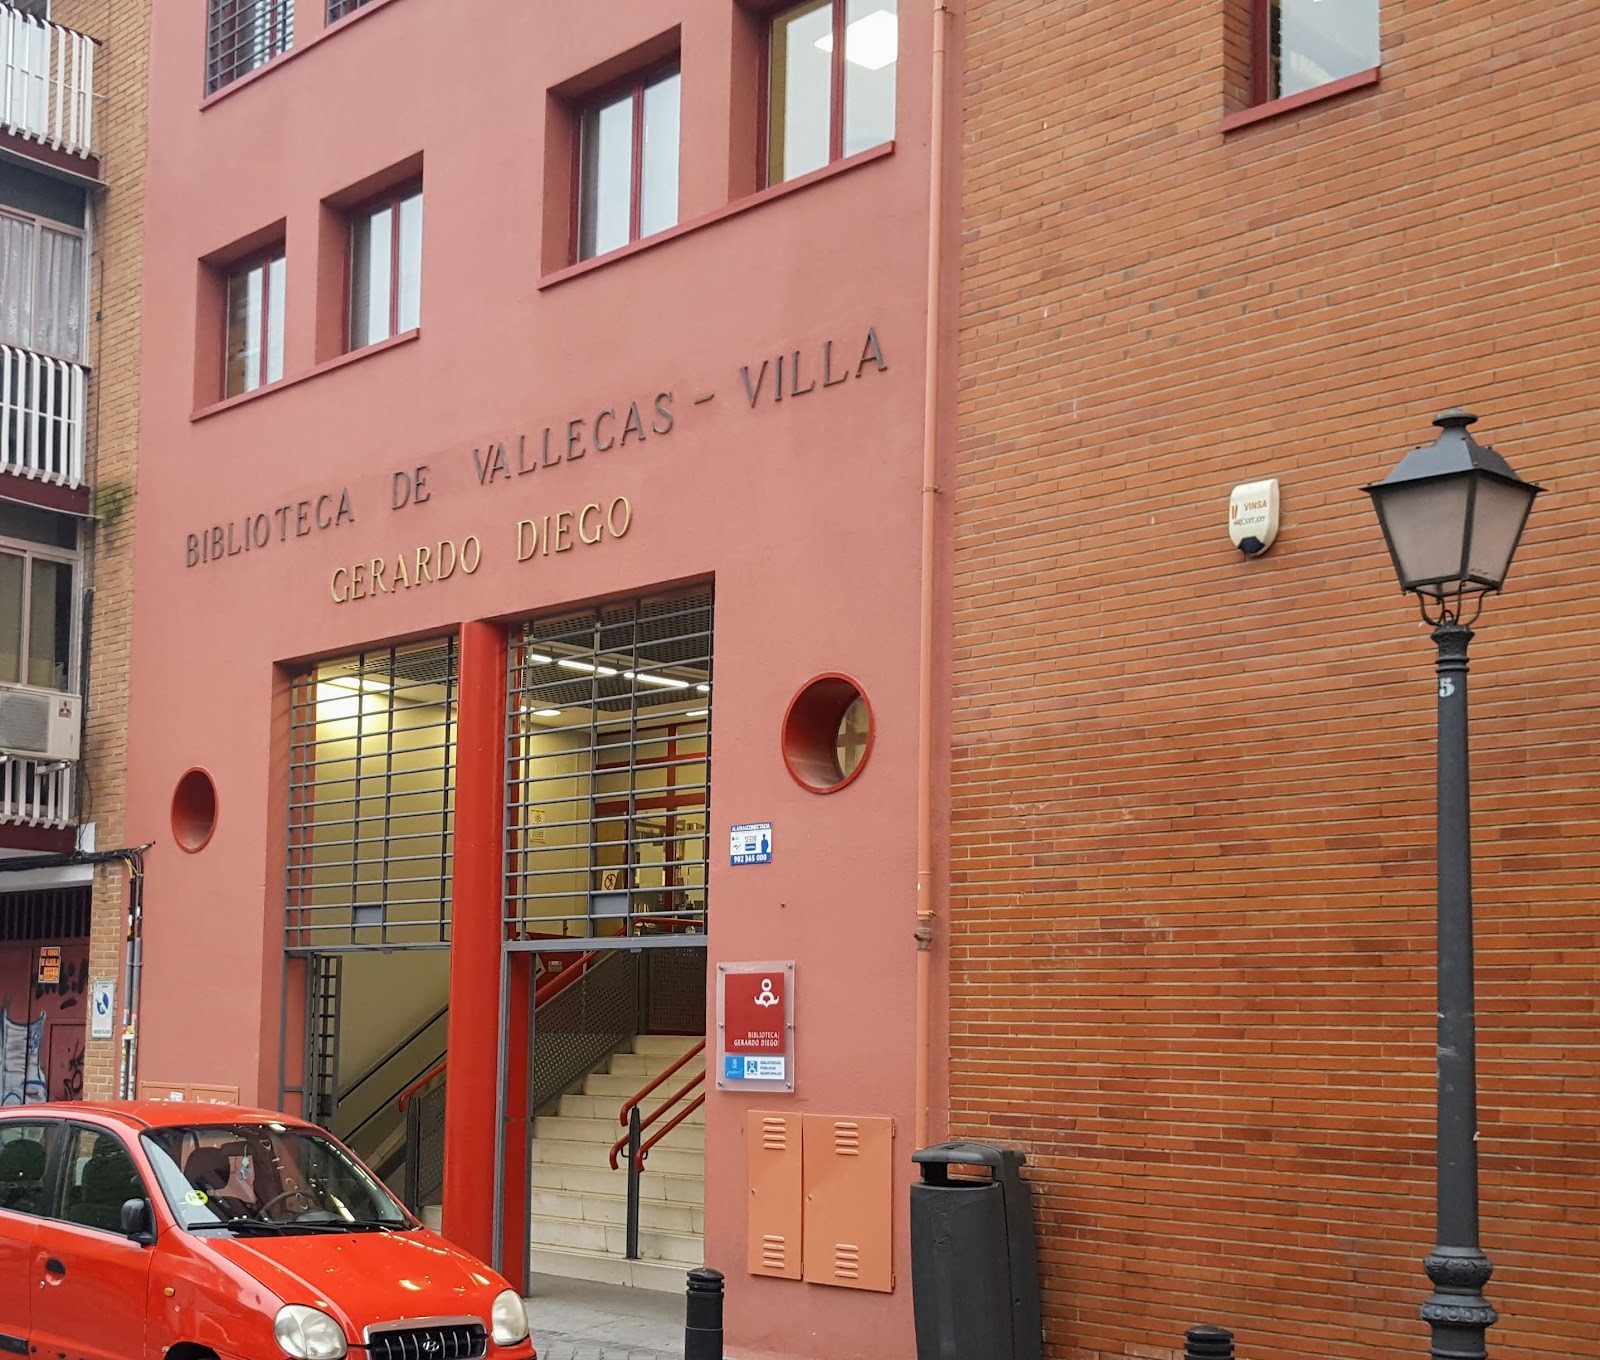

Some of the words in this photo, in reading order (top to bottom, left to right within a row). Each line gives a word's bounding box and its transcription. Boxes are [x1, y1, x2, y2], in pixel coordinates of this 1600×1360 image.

[186, 488, 356, 568] BIBLIOTECA
[391, 465, 432, 511] DE
[472, 391, 675, 486] VALLECAS
[739, 327, 888, 409] VILLA
[330, 534, 483, 605] GERARDO
[516, 495, 634, 563] DIEGO
[1439, 677, 1454, 698] 5
